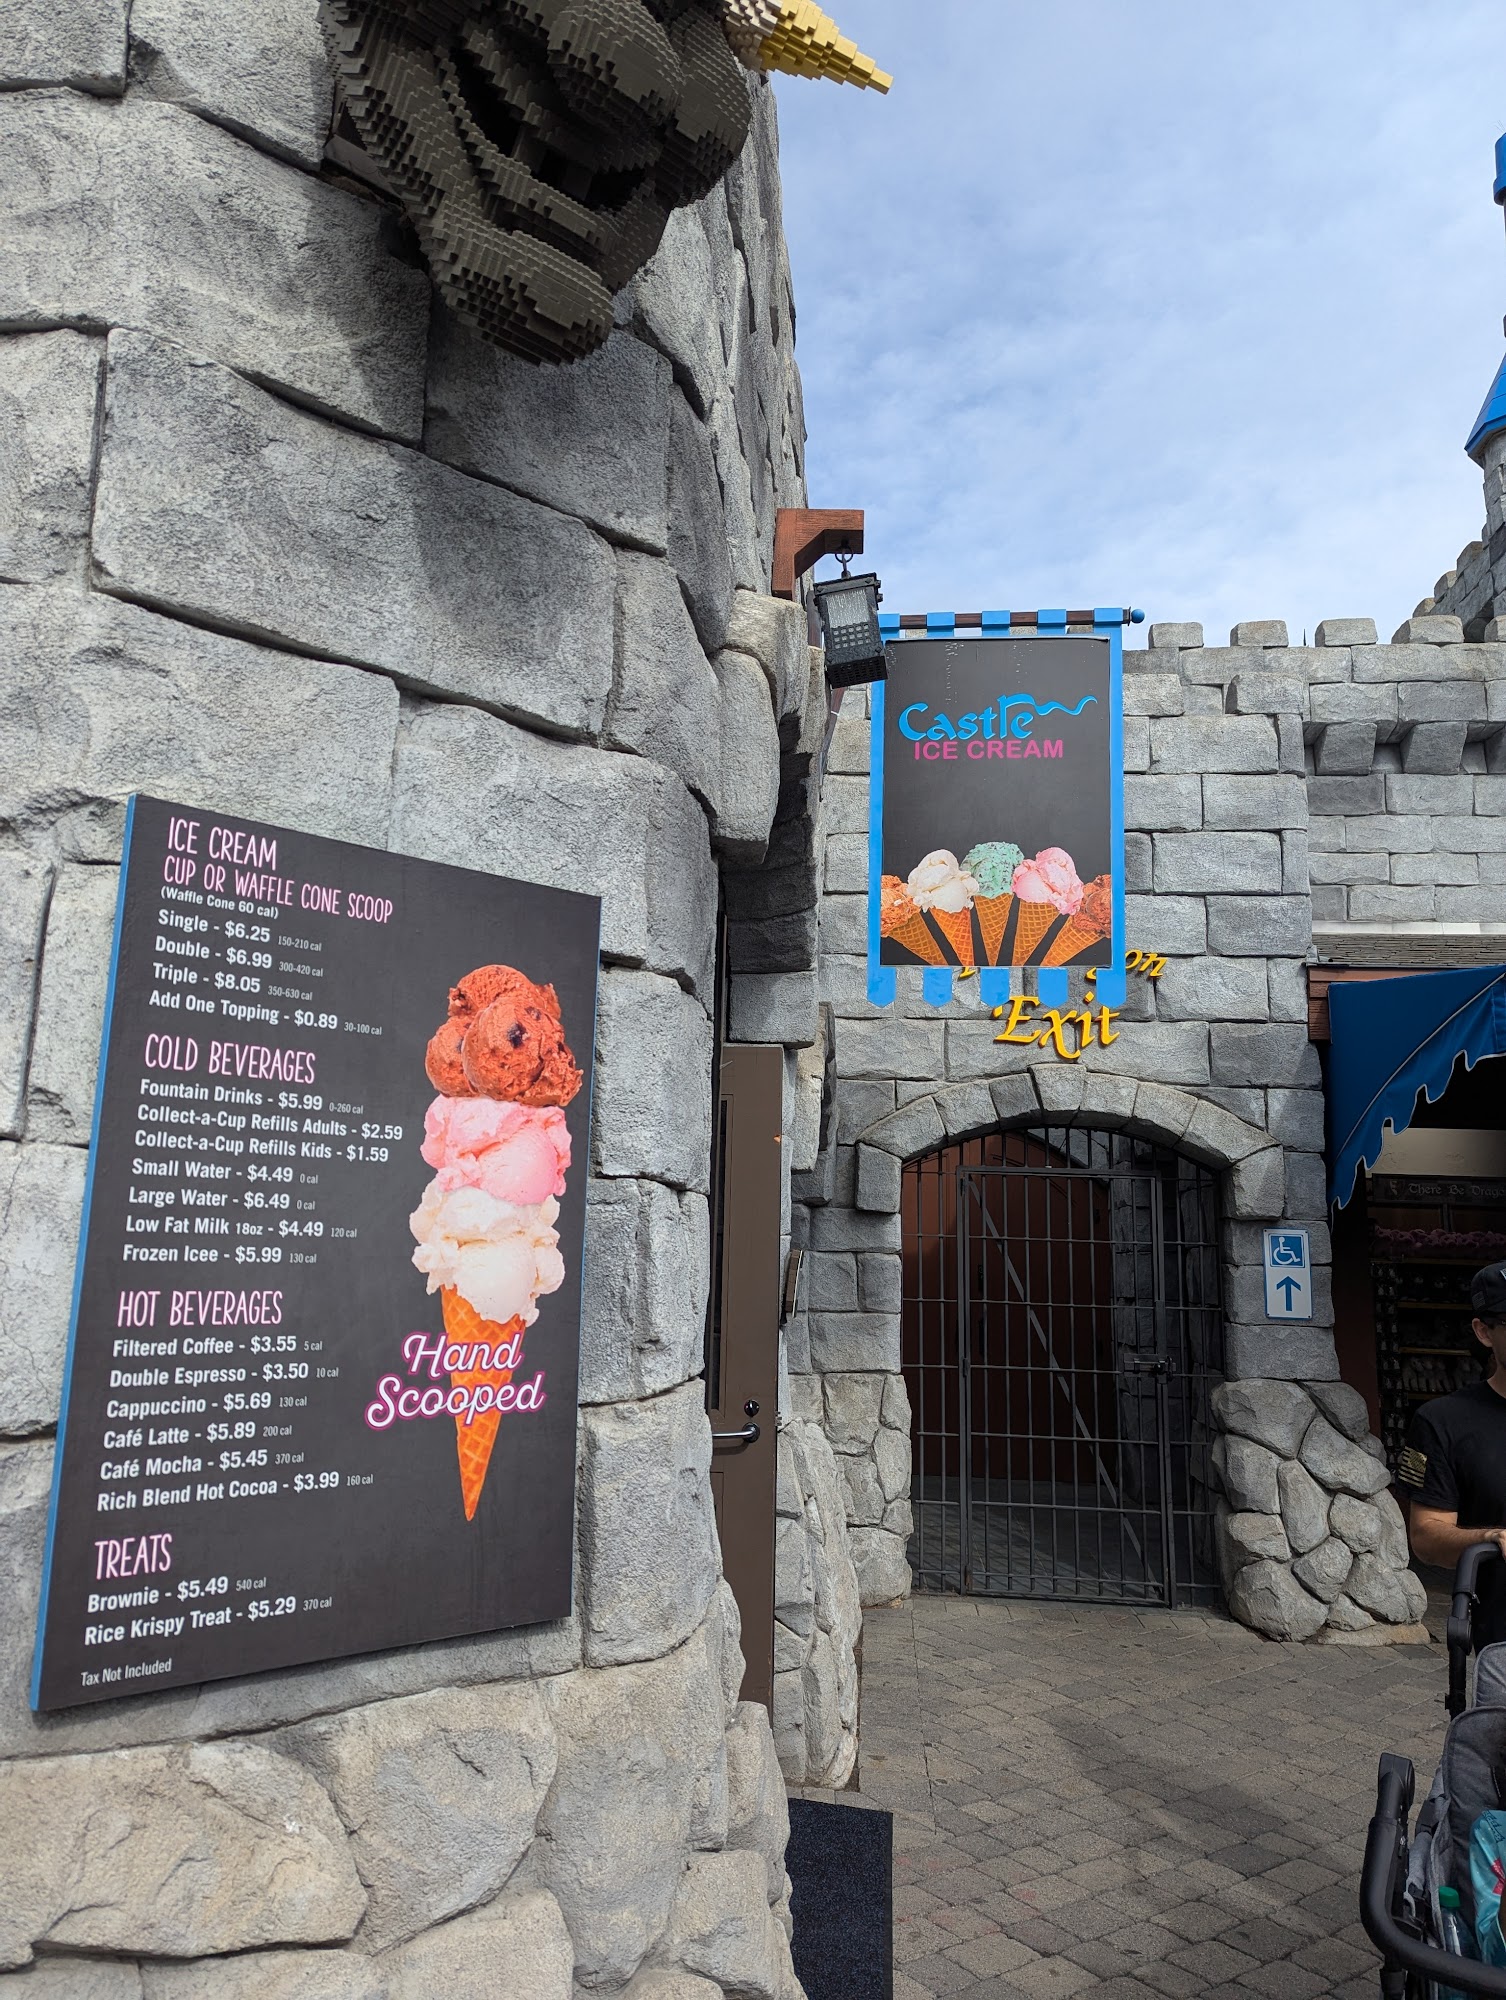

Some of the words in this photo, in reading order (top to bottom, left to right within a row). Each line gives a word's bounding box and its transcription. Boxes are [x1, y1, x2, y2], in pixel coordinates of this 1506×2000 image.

[898, 693, 1097, 740] Castle
[914, 741, 958, 760] ICE
[967, 740, 1063, 759] CREAM
[167, 817, 200, 854] ICE
[209, 827, 277, 871] CREAM
[161, 886, 203, 905] (Waffle
[207, 895, 235, 911] Cone
[238, 903, 253, 913] 60
[257, 905, 279, 920] cal)
[164, 855, 196, 886] CUP
[204, 864, 226, 892] OR
[235, 869, 295, 905] WAFFLE
[301, 883, 341, 915] CONE
[347, 893, 393, 924] SCOOP
[158, 909, 208, 933] Single
[225, 920, 271, 942] $6.25
[278, 936, 309, 950] 150-210
[310, 942, 322, 952] cal
[155, 935, 210, 958] Double
[226, 947, 272, 969] $6.99
[279, 961, 310, 976] 300-420
[311, 967, 323, 977] cal
[153, 962, 197, 987] Triple
[214, 971, 260, 993] $8.05
[268, 986, 299, 999] 350-630
[301, 991, 312, 1001] cal
[149, 990, 180, 1009] Add
[186, 995, 215, 1013] One
[221, 999, 280, 1025] Topping
[294, 1009, 338, 1030] $0.89
[344, 1022, 370, 1034] 30-100
[371, 1025, 382, 1035] cal
[993, 991, 1120, 1059] Exit
[145, 1033, 198, 1072] COLD
[209, 1041, 316, 1084] BEVERAGES
[140, 1078, 209, 1100] Fountain
[214, 1085, 263, 1105] Drinks
[278, 1092, 323, 1111] $5.99
[329, 1102, 352, 1113] 0-260
[352, 1104, 363, 1114] cal
[138, 1104, 246, 1131] Collect-a-Cup
[251, 1114, 298, 1132] Refills
[302, 1118, 347, 1136] Adults
[361, 1122, 403, 1140] $2.59
[135, 1129, 243, 1156] Collect-a-Cup
[249, 1138, 296, 1156] Refills
[301, 1141, 332, 1159] Kids
[347, 1144, 389, 1162] $1.59
[132, 1158, 179, 1176] Small
[185, 1161, 231, 1179] Water
[247, 1164, 293, 1183] $4.49
[300, 1174, 305, 1184] 0
[307, 1175, 318, 1184] cal
[1408, 1183, 1442, 1195] There
[1447, 1184, 1465, 1195] Be
[129, 1186, 175, 1208] Large
[181, 1189, 228, 1206] Water
[244, 1191, 290, 1210] $6.49
[296, 1200, 302, 1210] 0
[304, 1201, 315, 1210] cal
[126, 1215, 159, 1233] Low
[164, 1217, 189, 1234] Fat
[194, 1218, 229, 1235] Milk
[235, 1222, 263, 1235] 18oz
[279, 1220, 324, 1237] $4.49
[330, 1228, 344, 1238] 120
[345, 1228, 357, 1237] cal
[123, 1244, 178, 1261] Frozen
[184, 1245, 218, 1262] Icee
[235, 1246, 282, 1264] $5.99
[289, 1253, 304, 1264] 130
[305, 1253, 317, 1264] cal
[117, 1290, 161, 1327] HOT
[169, 1290, 283, 1326] BEVERAGES
[113, 1339, 177, 1357] Filtered
[183, 1337, 234, 1355] Coffee
[250, 1335, 297, 1355] $3.55
[304, 1341, 309, 1351] 5
[310, 1341, 323, 1351] cal
[402, 1332, 524, 1380] Hand
[110, 1368, 169, 1388] Double
[174, 1367, 246, 1386] Espresso
[262, 1363, 308, 1382] $3.50
[316, 1368, 325, 1378] 10
[327, 1367, 339, 1378] cal
[106, 1396, 206, 1421] Cappuccino
[223, 1392, 271, 1412] $5.69
[279, 1397, 294, 1407] 130
[295, 1396, 307, 1407] cal
[365, 1372, 546, 1429] Scooped
[103, 1428, 143, 1449] Café
[148, 1427, 189, 1446] Latte
[206, 1422, 256, 1443] $5.89
[263, 1426, 278, 1437] 200
[279, 1425, 292, 1436] cal
[100, 1459, 139, 1480] Café
[146, 1456, 202, 1476] Mocha
[219, 1449, 268, 1470] $5.45
[275, 1454, 291, 1465] 370
[292, 1453, 304, 1463] cal
[97, 1492, 137, 1512] Rich
[142, 1487, 190, 1507] Blend
[196, 1483, 224, 1502] Hot
[229, 1480, 277, 1498] Cocoa
[293, 1472, 339, 1493] $3.99
[347, 1476, 361, 1486] 160
[362, 1474, 373, 1485] cal
[95, 1533, 173, 1580] TREATS
[87, 1587, 159, 1613] Brownie
[177, 1576, 228, 1602] $5.49
[236, 1579, 252, 1591] 540
[253, 1577, 266, 1589] cal
[84, 1625, 125, 1646] Rice
[131, 1617, 184, 1639] Krispy
[190, 1607, 231, 1629] Treat
[248, 1596, 296, 1621] $5.29
[303, 1599, 319, 1611] 370
[320, 1597, 332, 1608] cal
[81, 1671, 99, 1687] Tax
[102, 1667, 122, 1683] Not
[125, 1658, 172, 1679] Included
